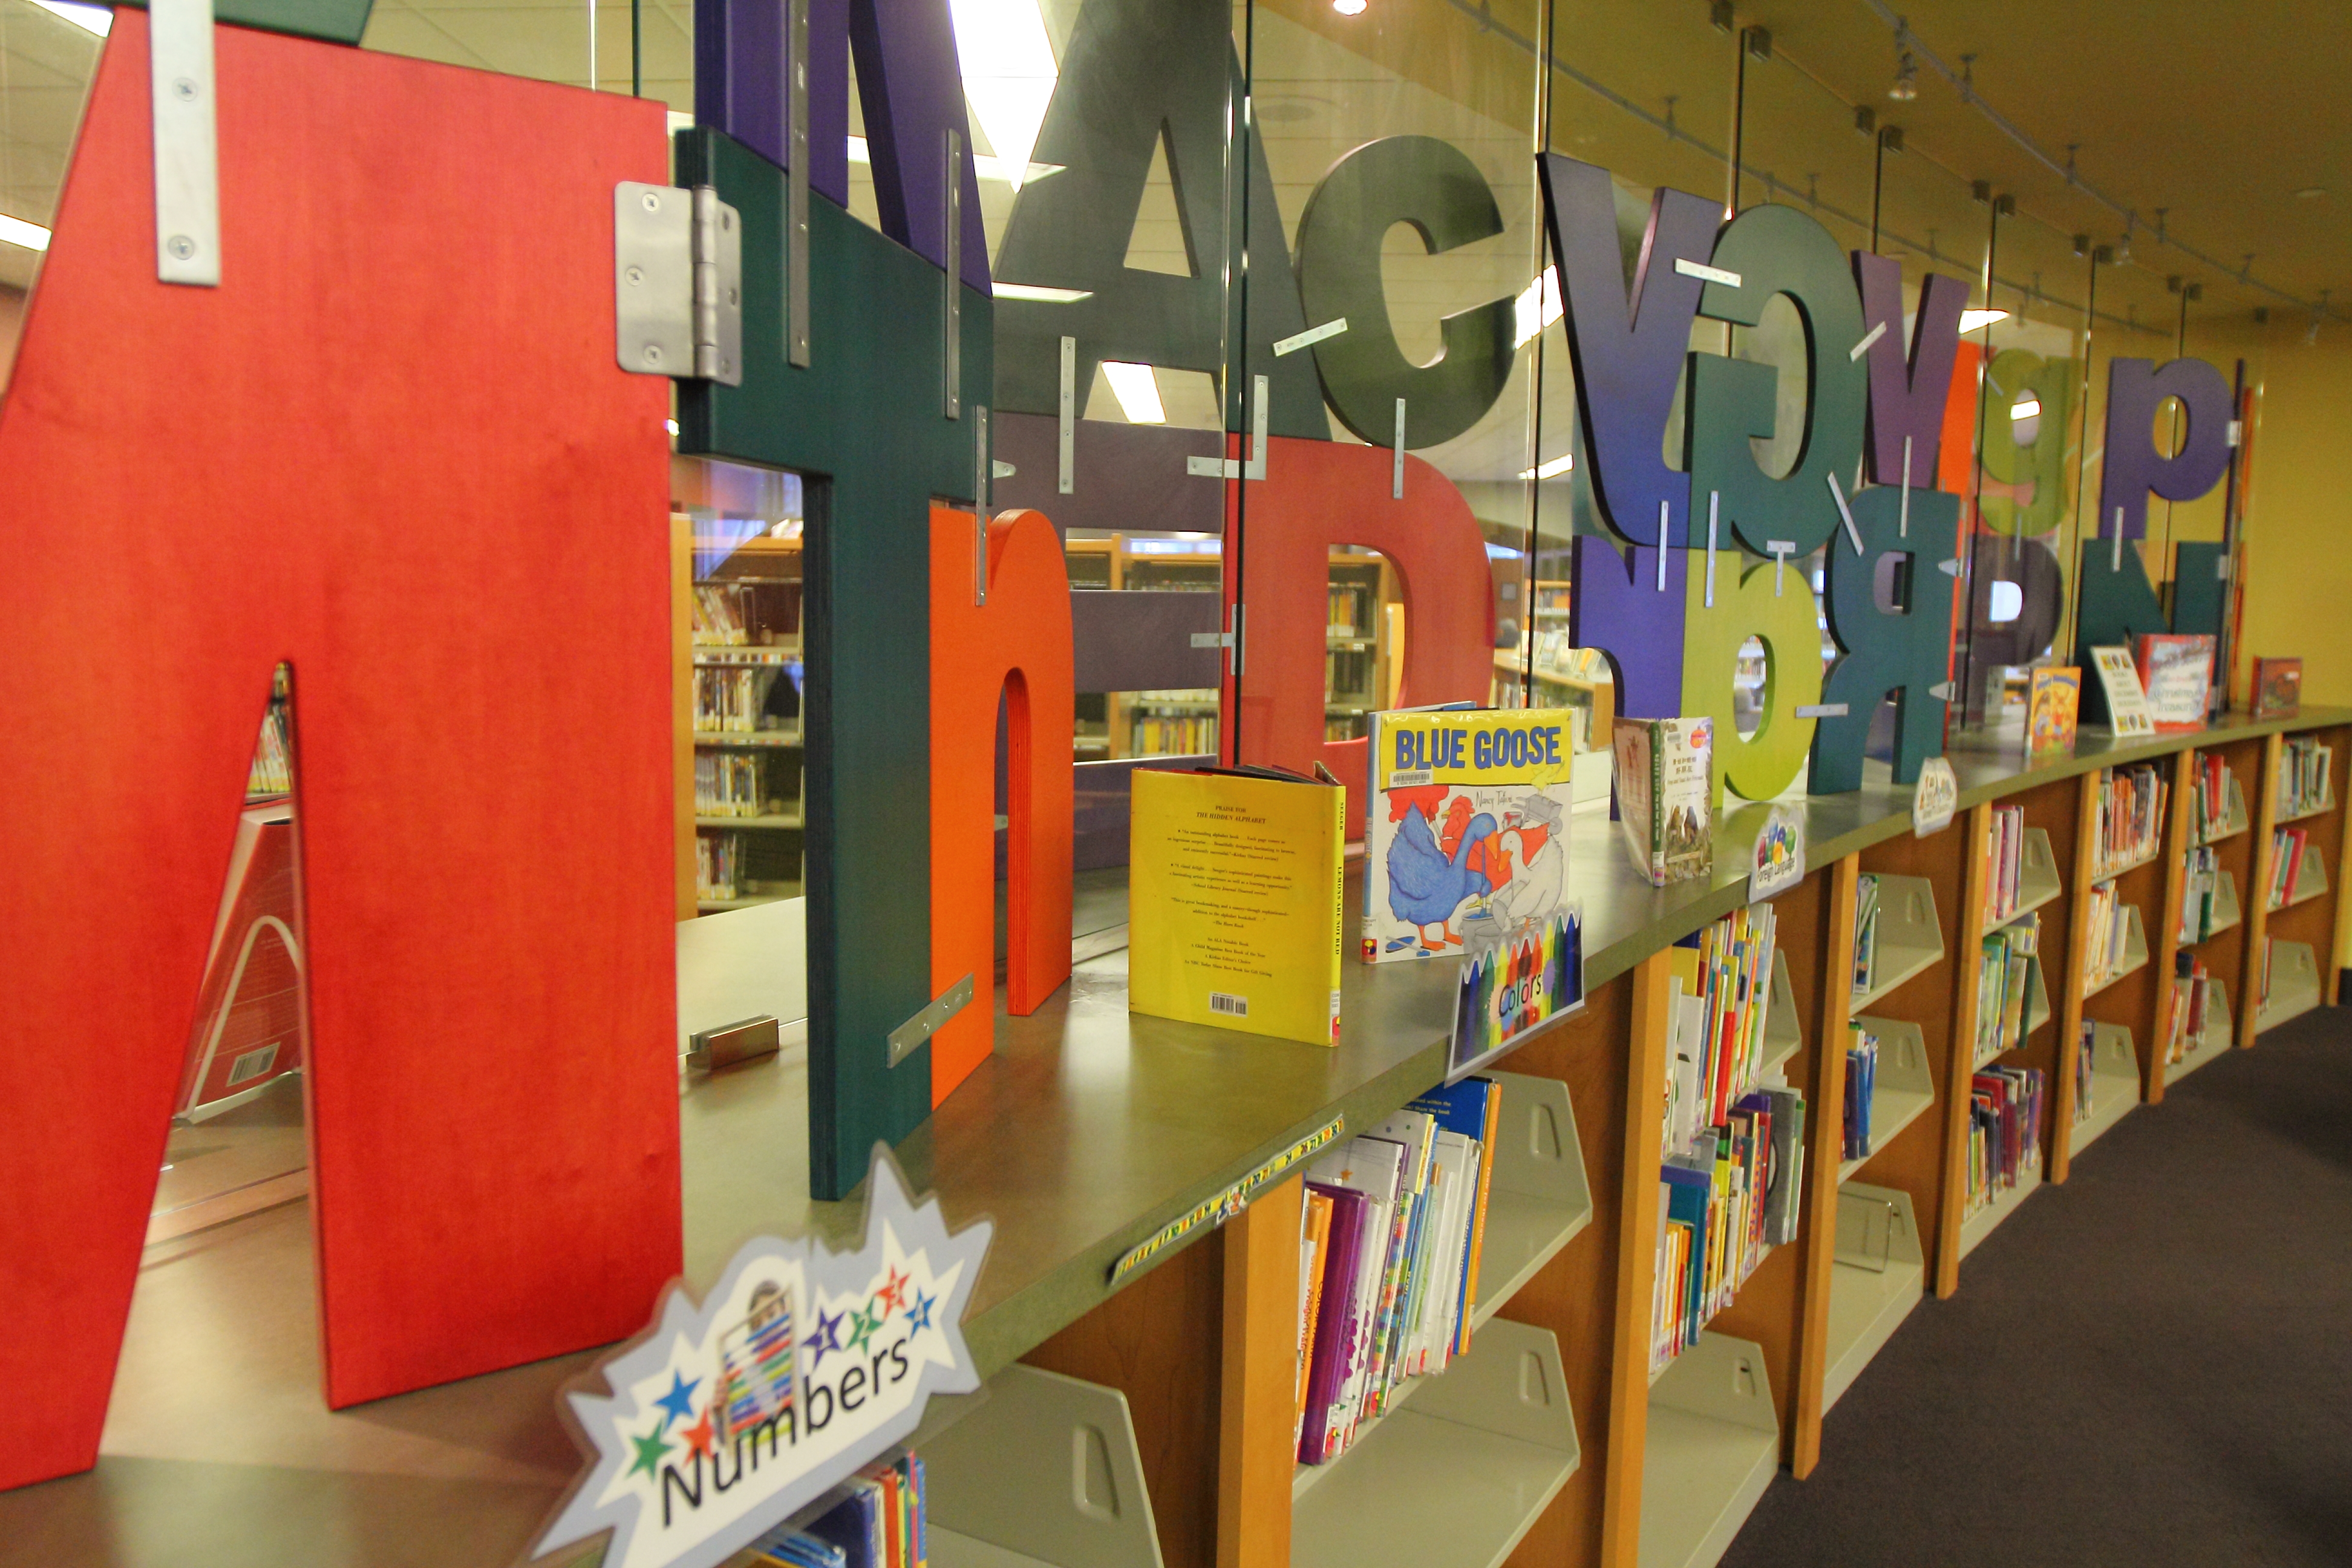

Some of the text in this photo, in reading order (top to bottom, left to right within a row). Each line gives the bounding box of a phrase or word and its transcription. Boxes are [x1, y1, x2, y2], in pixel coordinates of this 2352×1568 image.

[1396, 726, 1561, 769] BLUE GOOSE
[1476, 791, 1494, 807] Nancy
[1775, 857, 1795, 875] Language
[1499, 974, 1541, 1017] Colors
[818, 1280, 926, 1349] 1 2 3 4
[662, 1338, 909, 1527] Numbers
